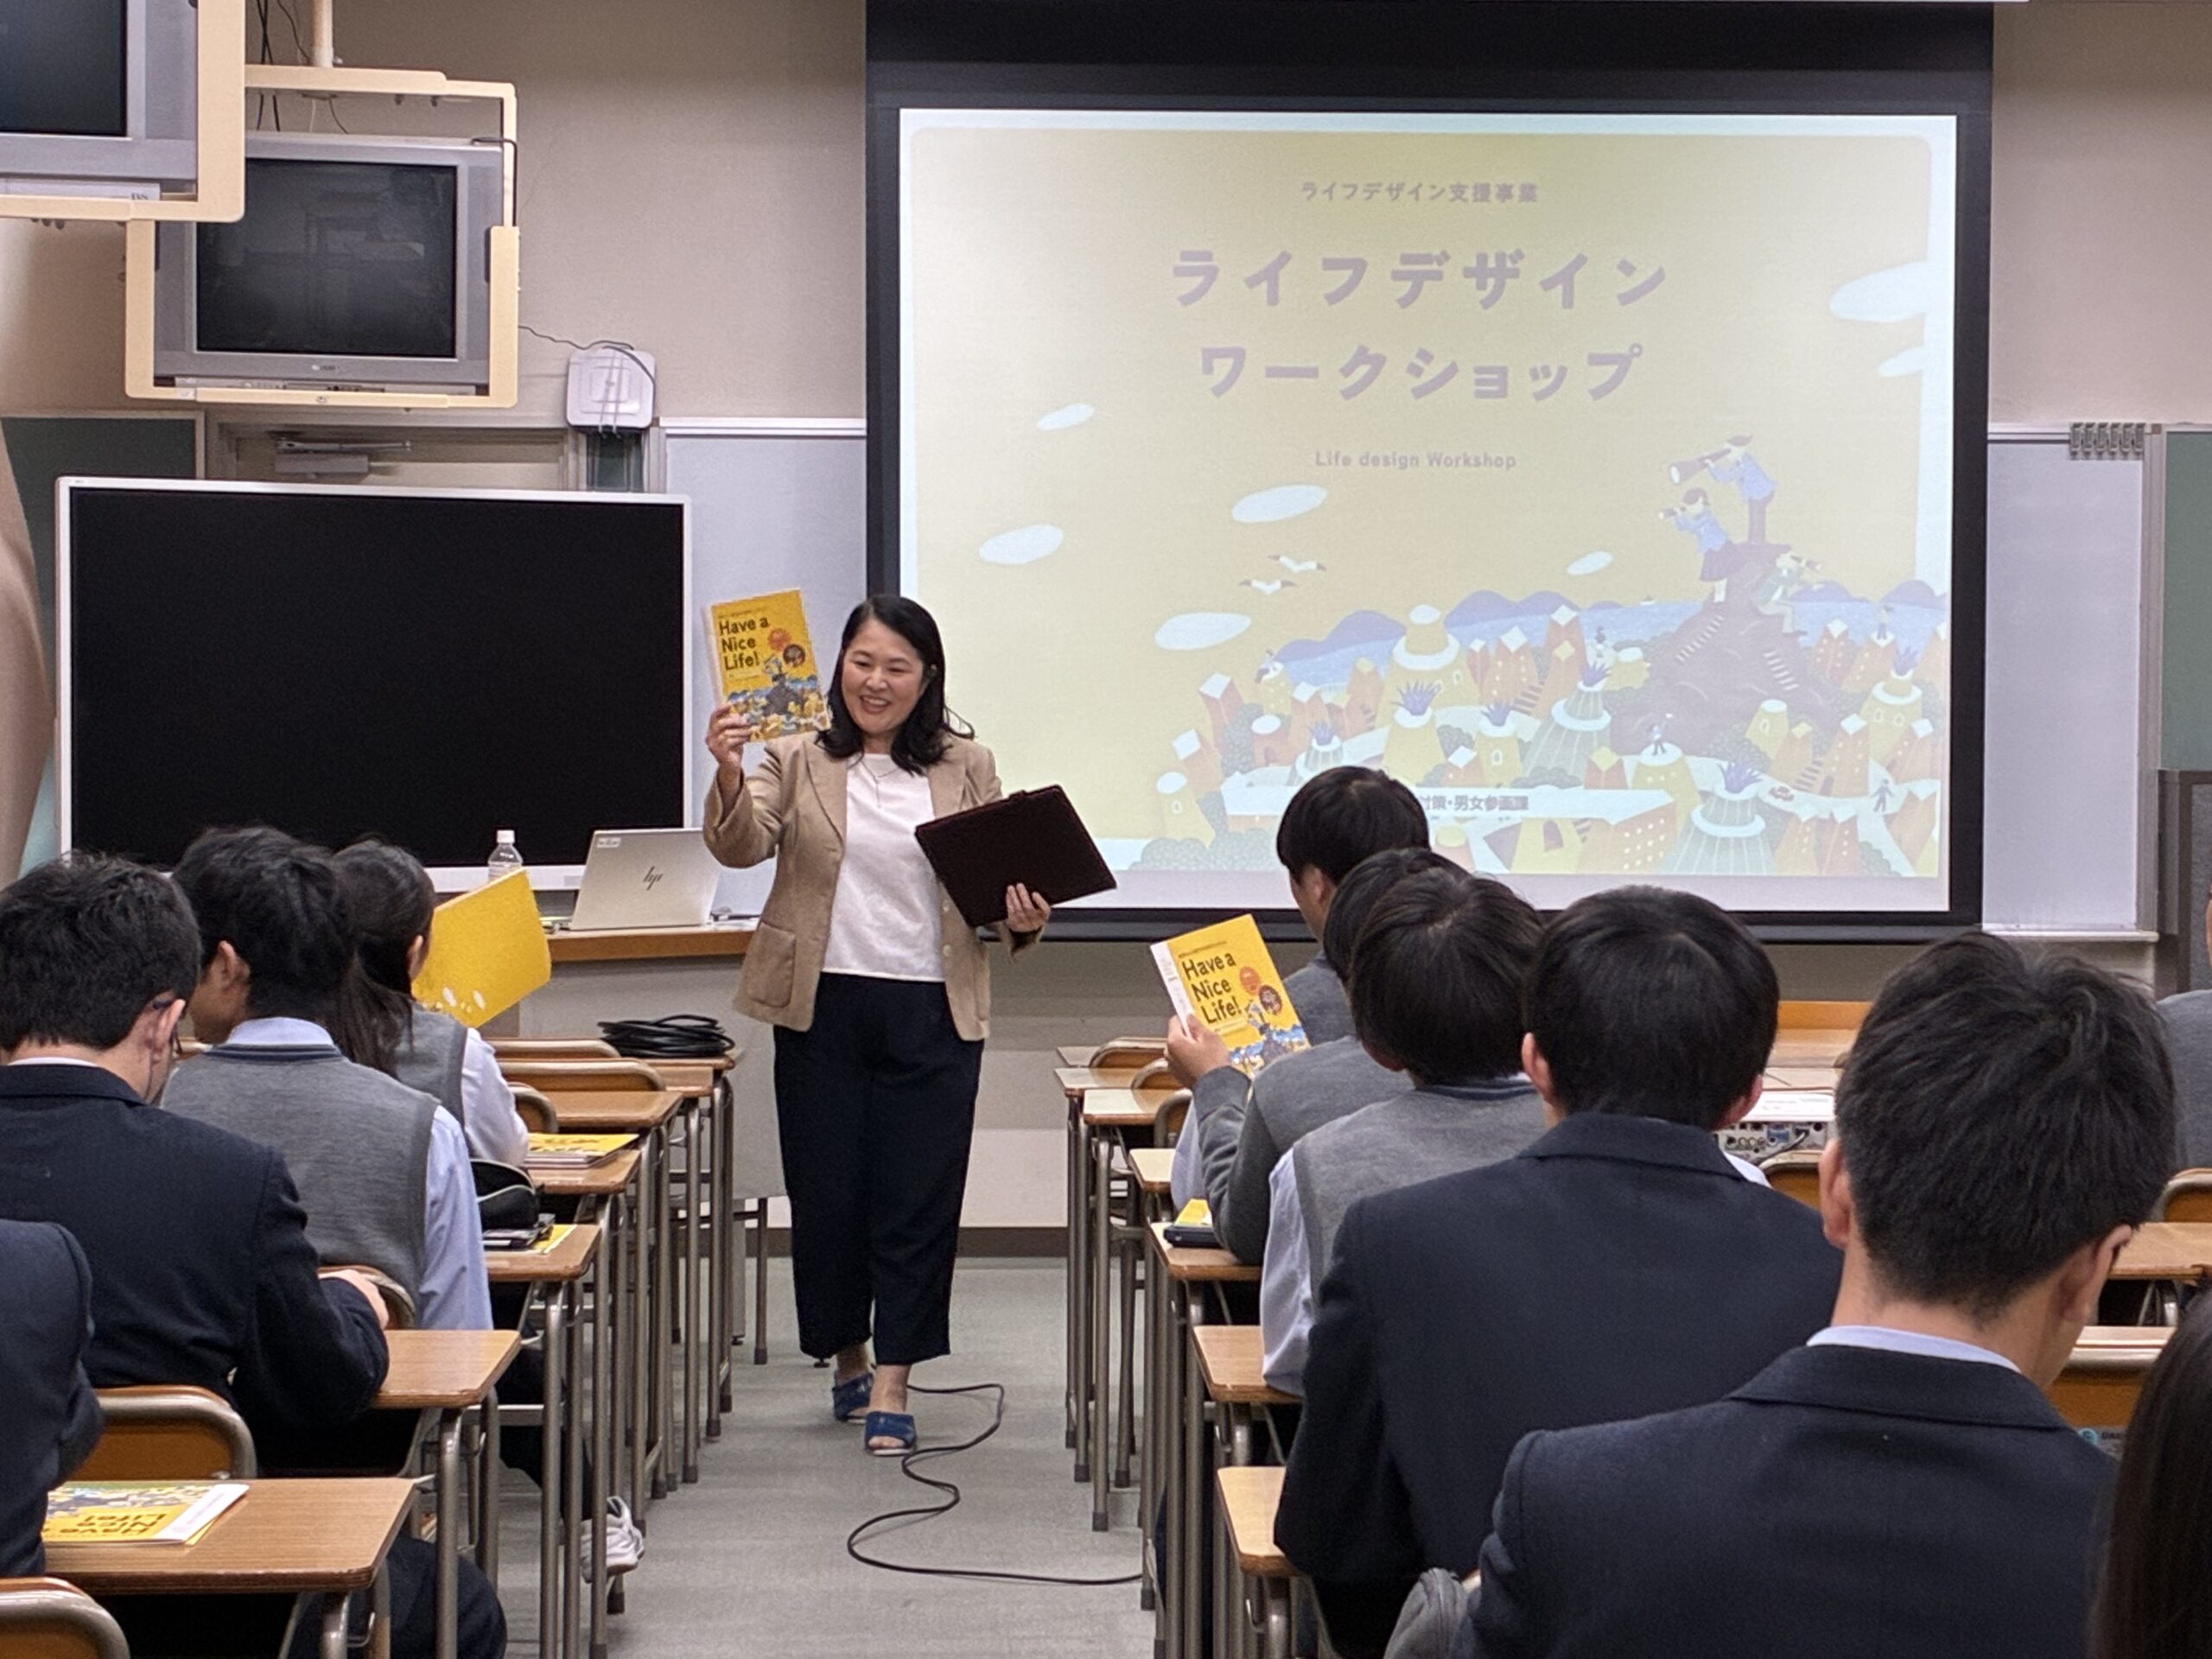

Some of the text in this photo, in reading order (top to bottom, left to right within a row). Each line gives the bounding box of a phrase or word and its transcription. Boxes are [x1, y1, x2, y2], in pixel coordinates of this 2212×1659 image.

[1300, 181, 1538, 204] ライフデザイン支援事業
[1173, 249, 1666, 310] ライフデザイン
[1200, 342, 1644, 402] ワークショップ
[1315, 451, 1516, 470] Life design Workshop
[719, 616, 771, 636] Have a
[721, 637, 757, 653] Nice
[724, 650, 761, 671] Life!
[643, 865, 664, 892] hp
[1181, 952, 1236, 981] Have a
[1191, 978, 1232, 1002] Nice
[1200, 995, 1243, 1024] Life!
